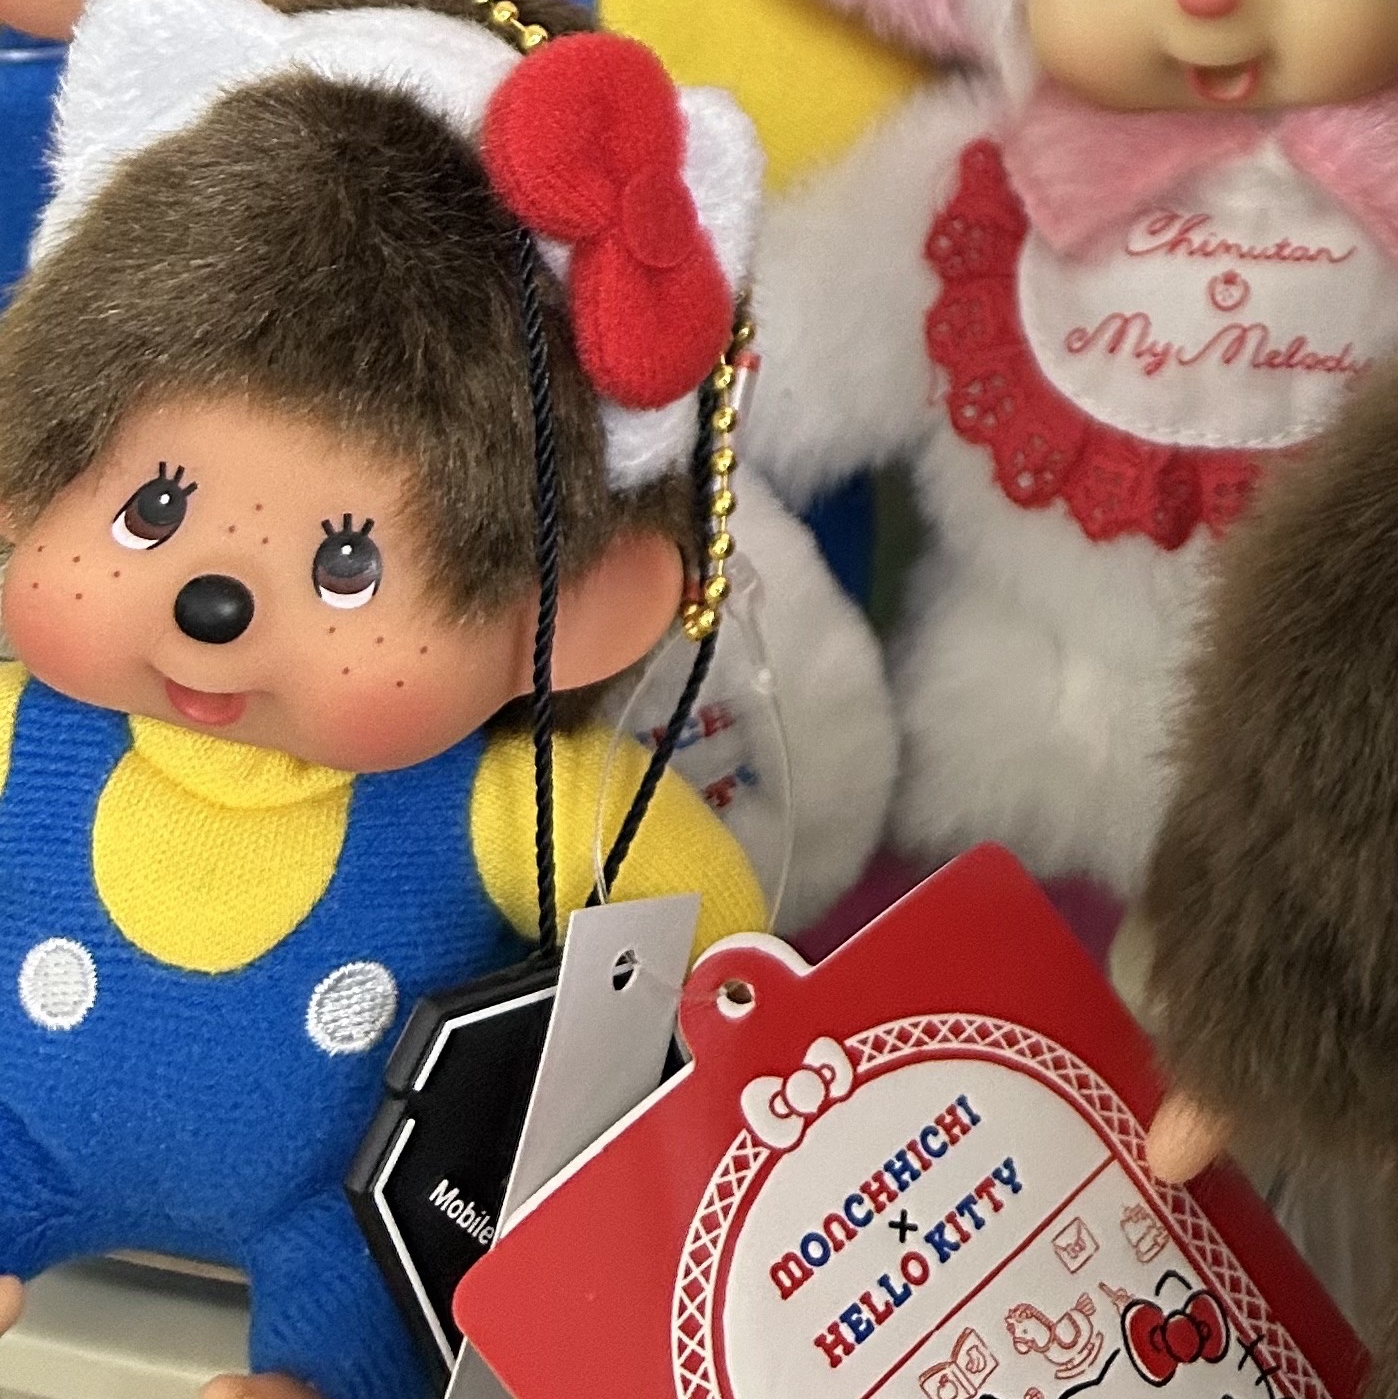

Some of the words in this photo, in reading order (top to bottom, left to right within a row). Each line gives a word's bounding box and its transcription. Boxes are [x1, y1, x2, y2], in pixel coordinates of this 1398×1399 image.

[1065, 312, 1177, 375] My
[428, 1178, 495, 1245] Mobile
[813, 1250, 930, 1369] HELLO
[924, 1156, 1023, 1264] KITTY
